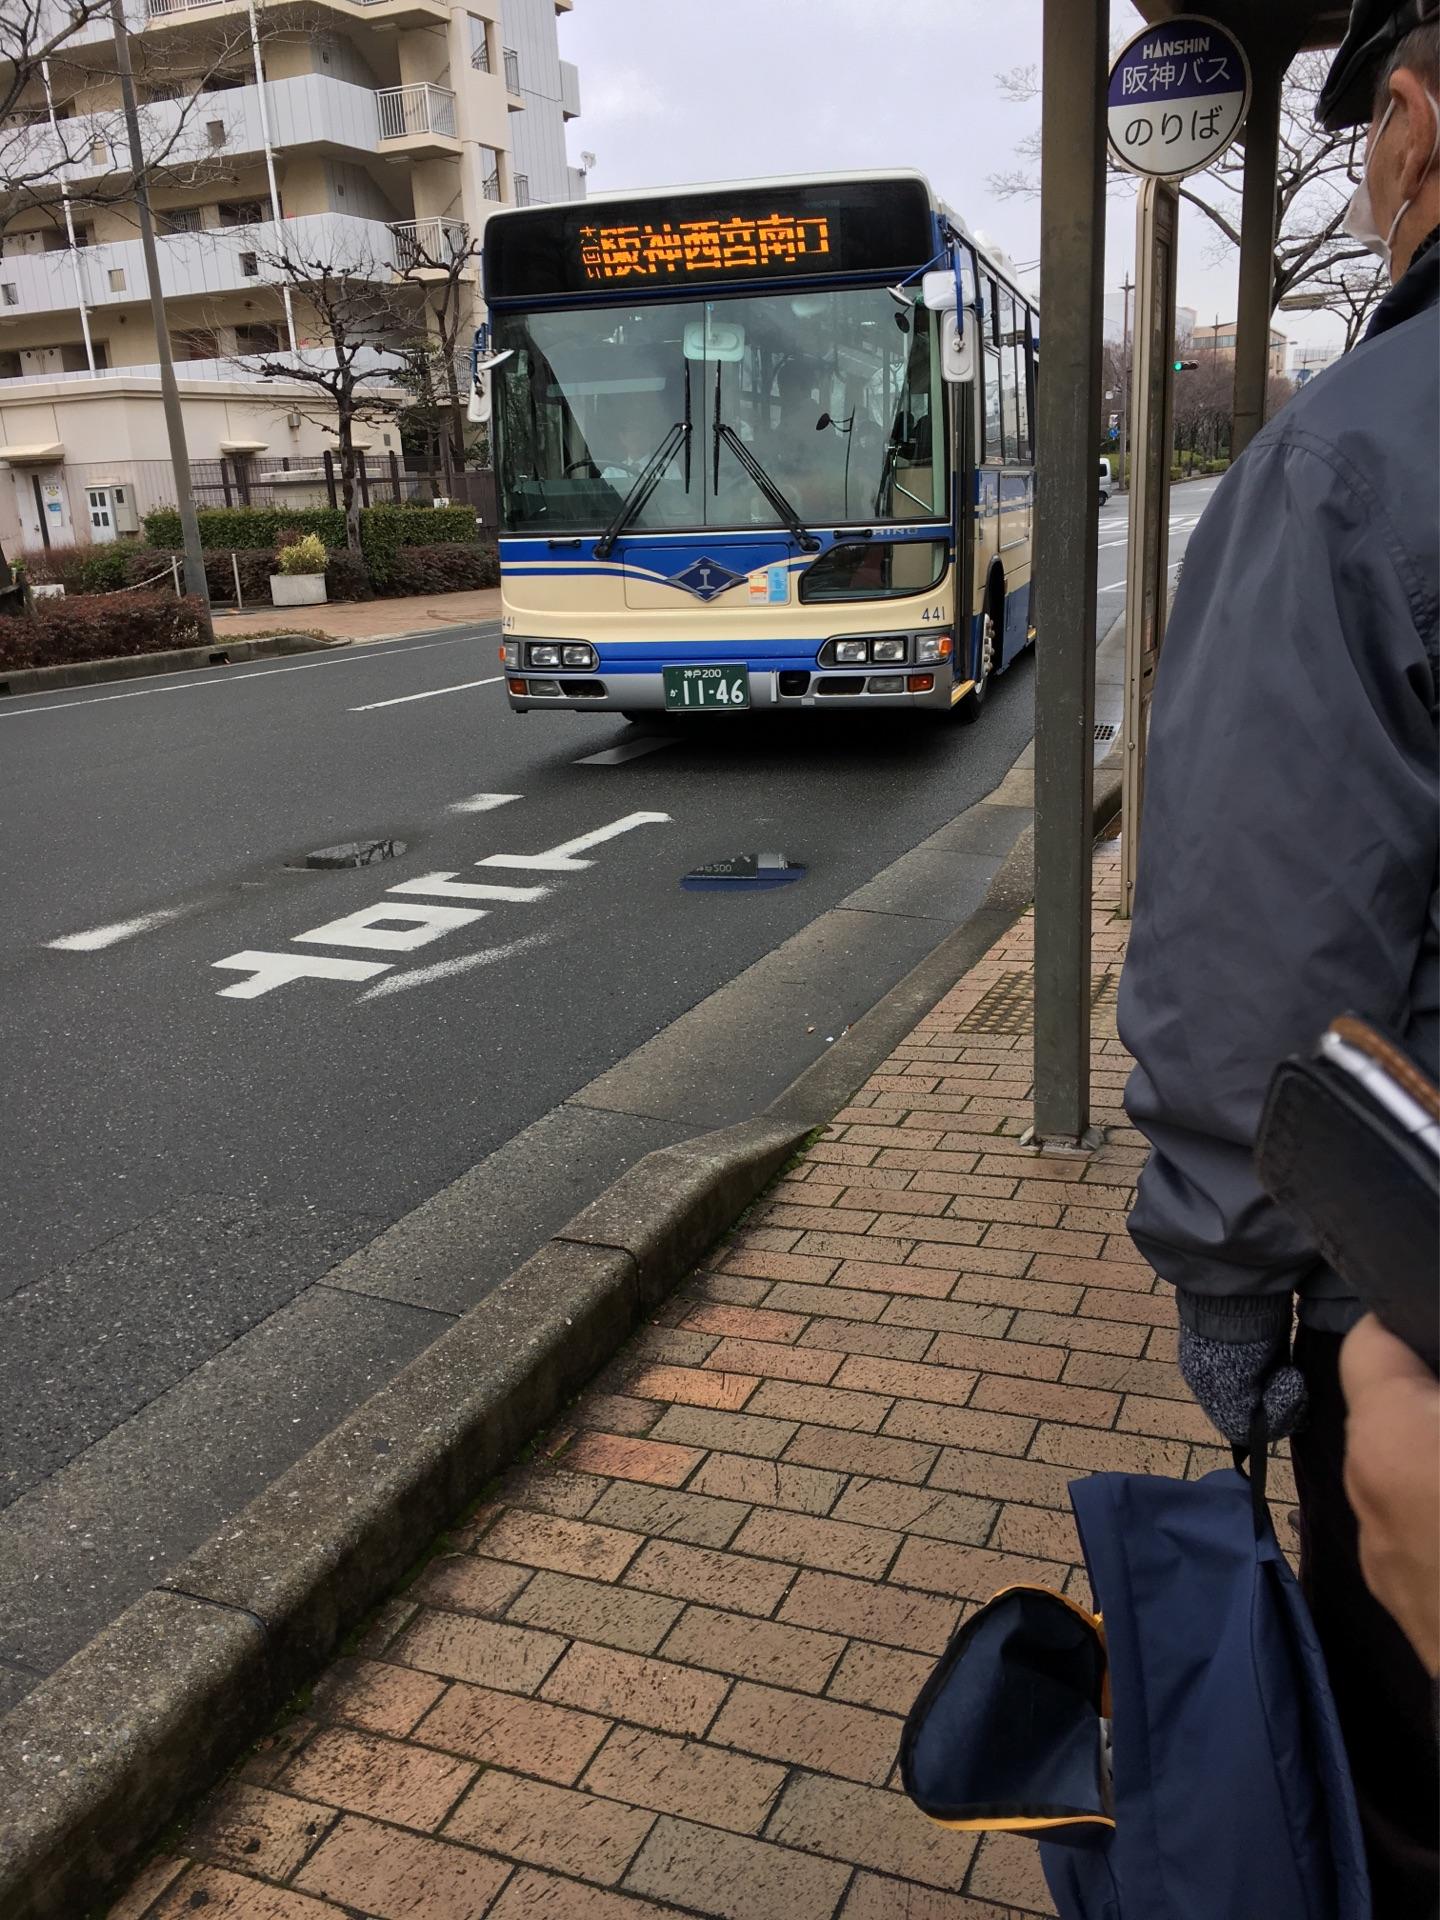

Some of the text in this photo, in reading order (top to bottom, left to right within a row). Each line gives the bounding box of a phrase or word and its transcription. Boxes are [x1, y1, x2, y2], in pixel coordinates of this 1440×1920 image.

[1143, 37, 1210, 59] HANSHIN
[1122, 57, 1230, 95] 阪神バス
[1125, 105, 1223, 146] のりば
[600, 213, 829, 277] 阪神西宮南口
[921, 605, 945, 621] 441
[683, 679, 744, 705] 11-46
